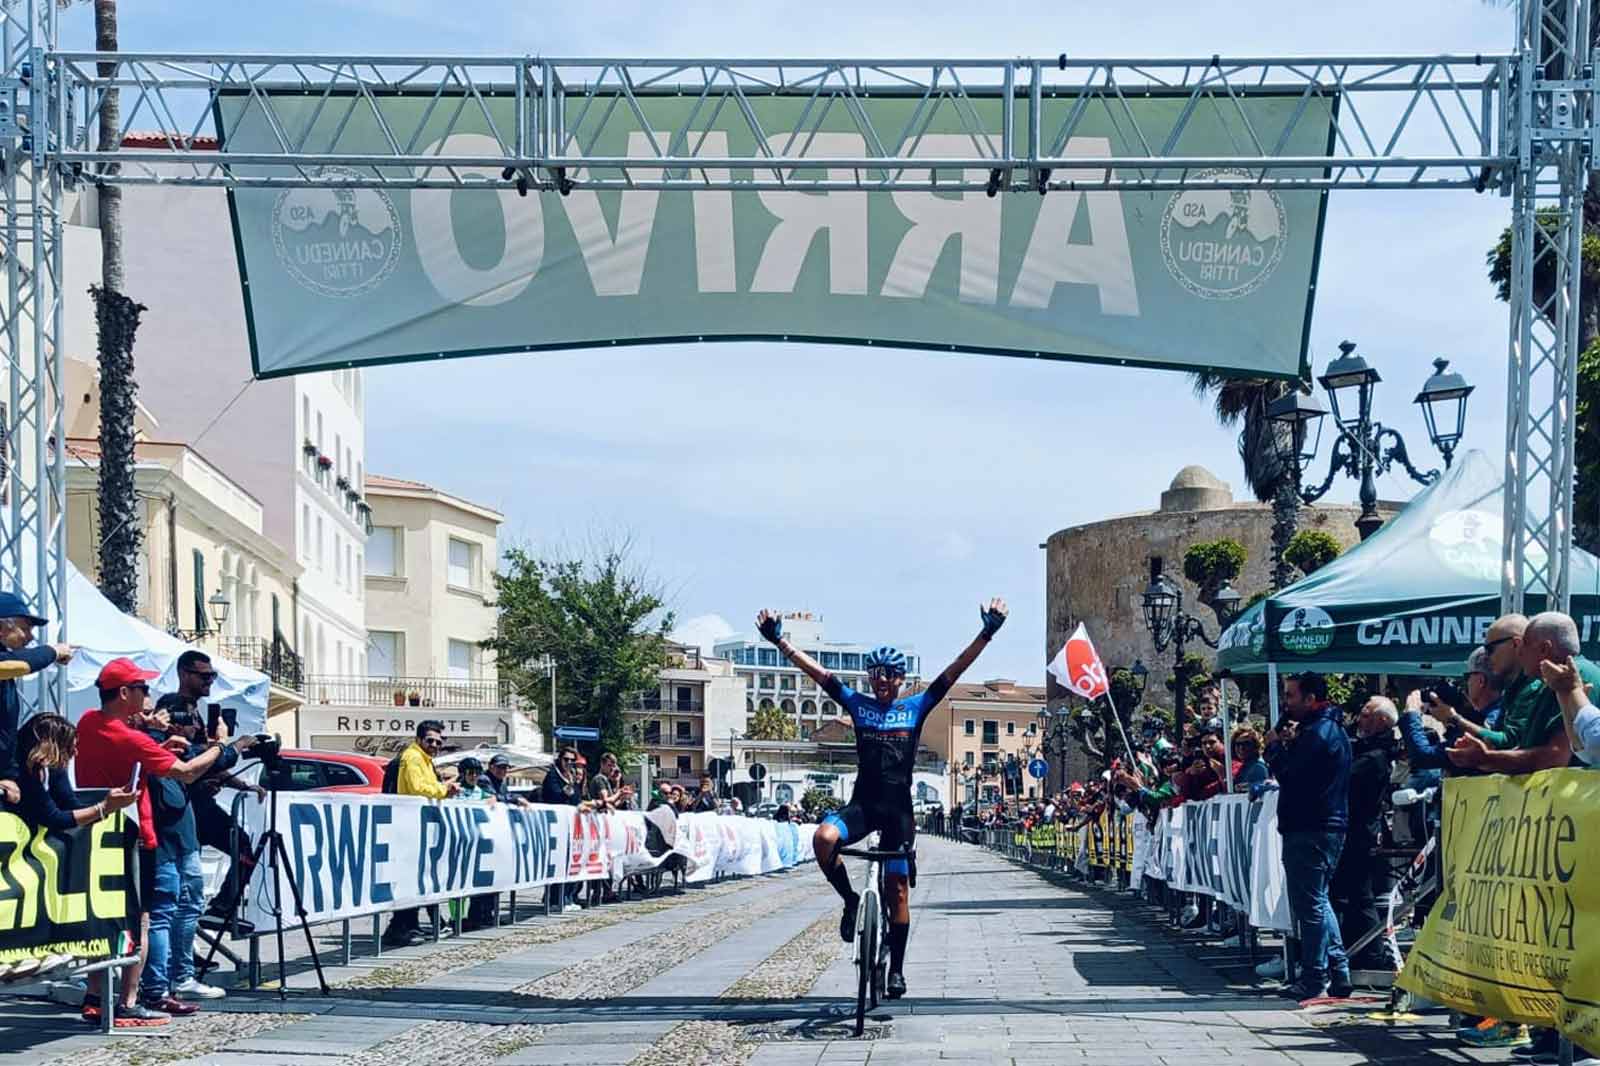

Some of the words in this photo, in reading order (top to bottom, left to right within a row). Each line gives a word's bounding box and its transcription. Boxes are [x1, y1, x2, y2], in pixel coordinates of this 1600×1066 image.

[1357, 615, 1496, 646] CANNE
[337, 716, 471, 732] RISTORTE
[857, 706, 913, 723] DONORI
[1466, 787, 1577, 883] Trachite
[289, 803, 393, 913] RWE
[417, 805, 495, 896] RWE
[508, 808, 558, 884] RWE
